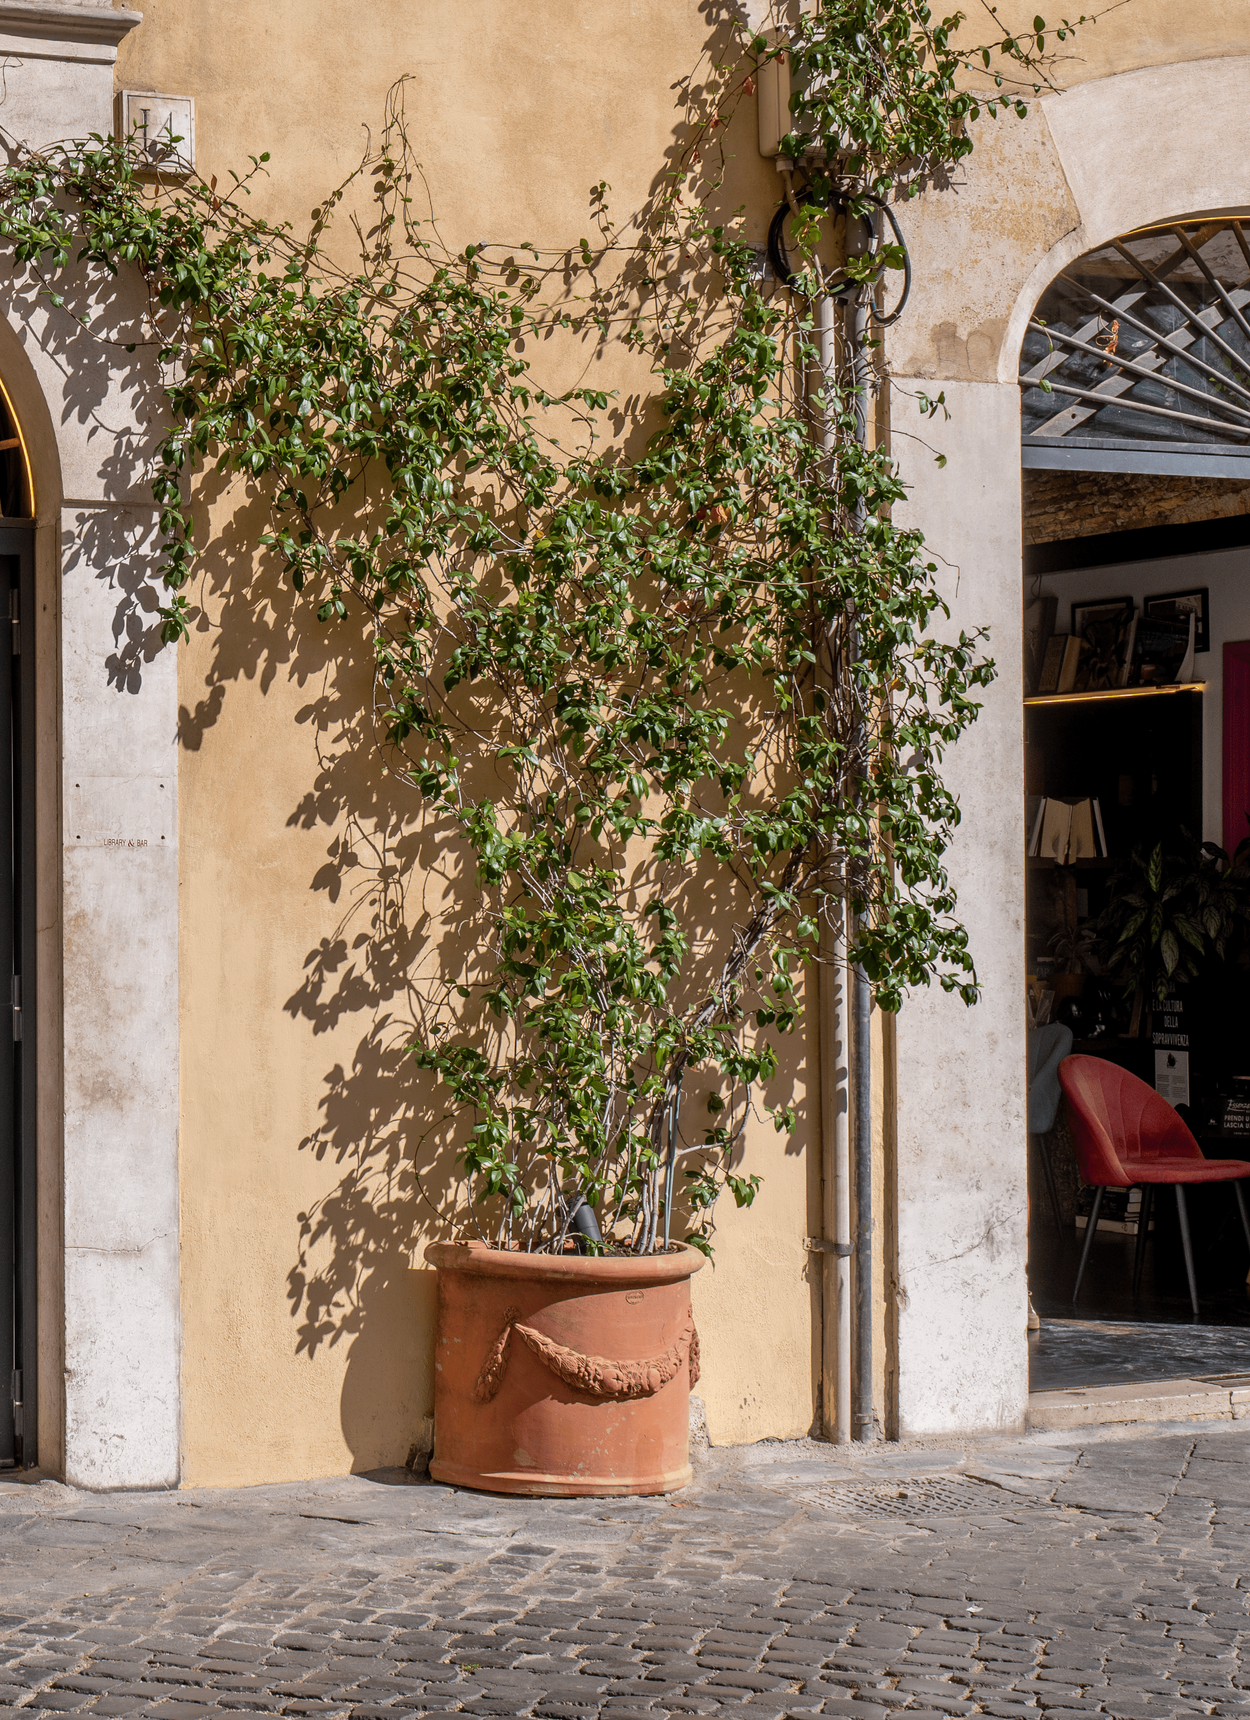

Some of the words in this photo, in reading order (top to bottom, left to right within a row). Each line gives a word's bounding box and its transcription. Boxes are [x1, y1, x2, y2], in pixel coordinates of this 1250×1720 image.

[103, 838, 126, 847] LIBRARY
[127, 838, 135, 848] &
[136, 839, 148, 847] BAR
[1163, 1000, 1184, 1013] CULTURA
[1164, 1015, 1179, 1028] DELLA
[1152, 1032, 1190, 1047] SOPRAVVIVENZA
[1224, 1114, 1244, 1122] PRENDI
